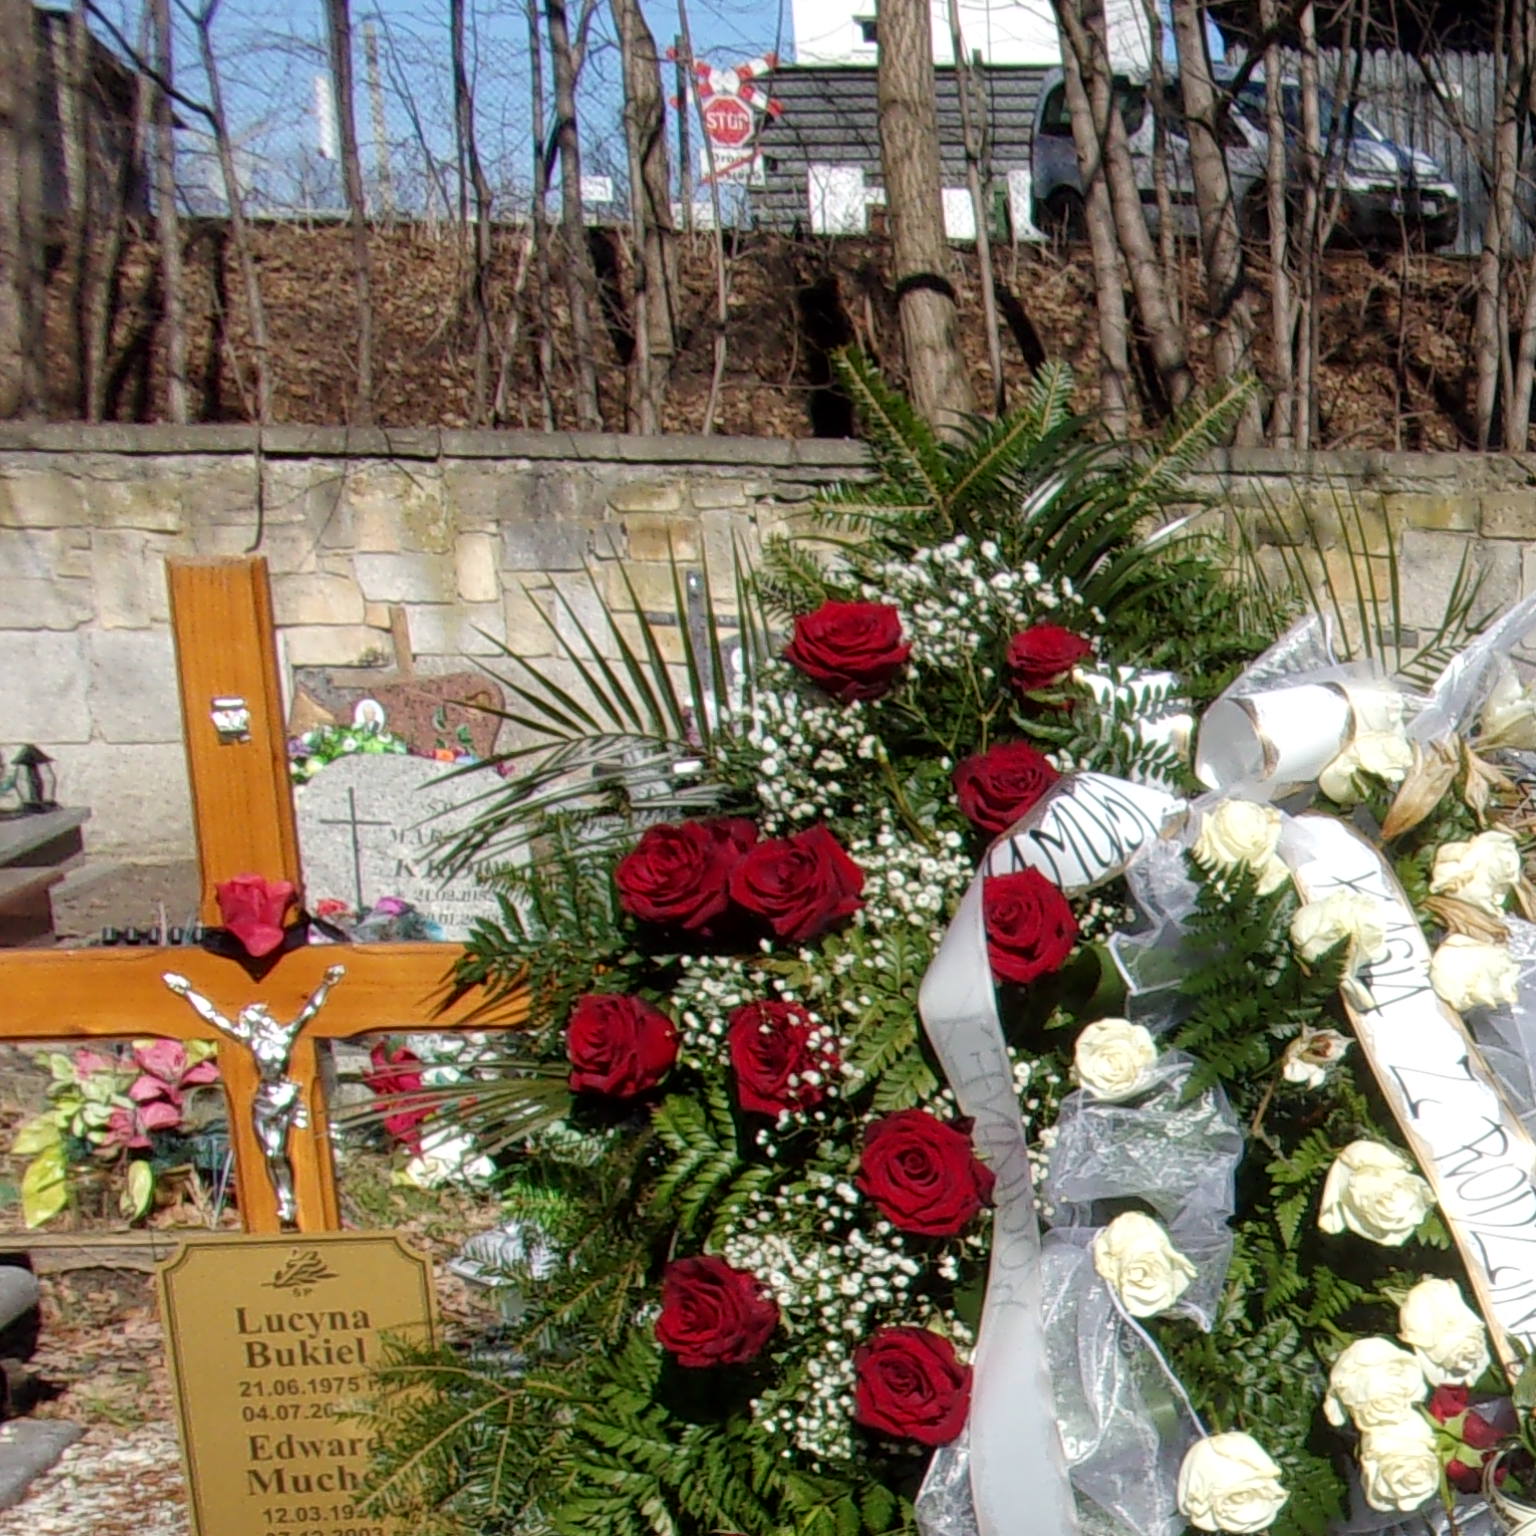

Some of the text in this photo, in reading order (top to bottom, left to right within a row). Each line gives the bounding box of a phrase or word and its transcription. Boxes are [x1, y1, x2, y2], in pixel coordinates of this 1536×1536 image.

[706, 112, 749, 131] STOP
[235, 1307, 371, 1338] Lucyna
[245, 1337, 367, 1369] Bukiel
[239, 1376, 360, 1398] 21.06.1975
[250, 1431, 386, 1461] Edward
